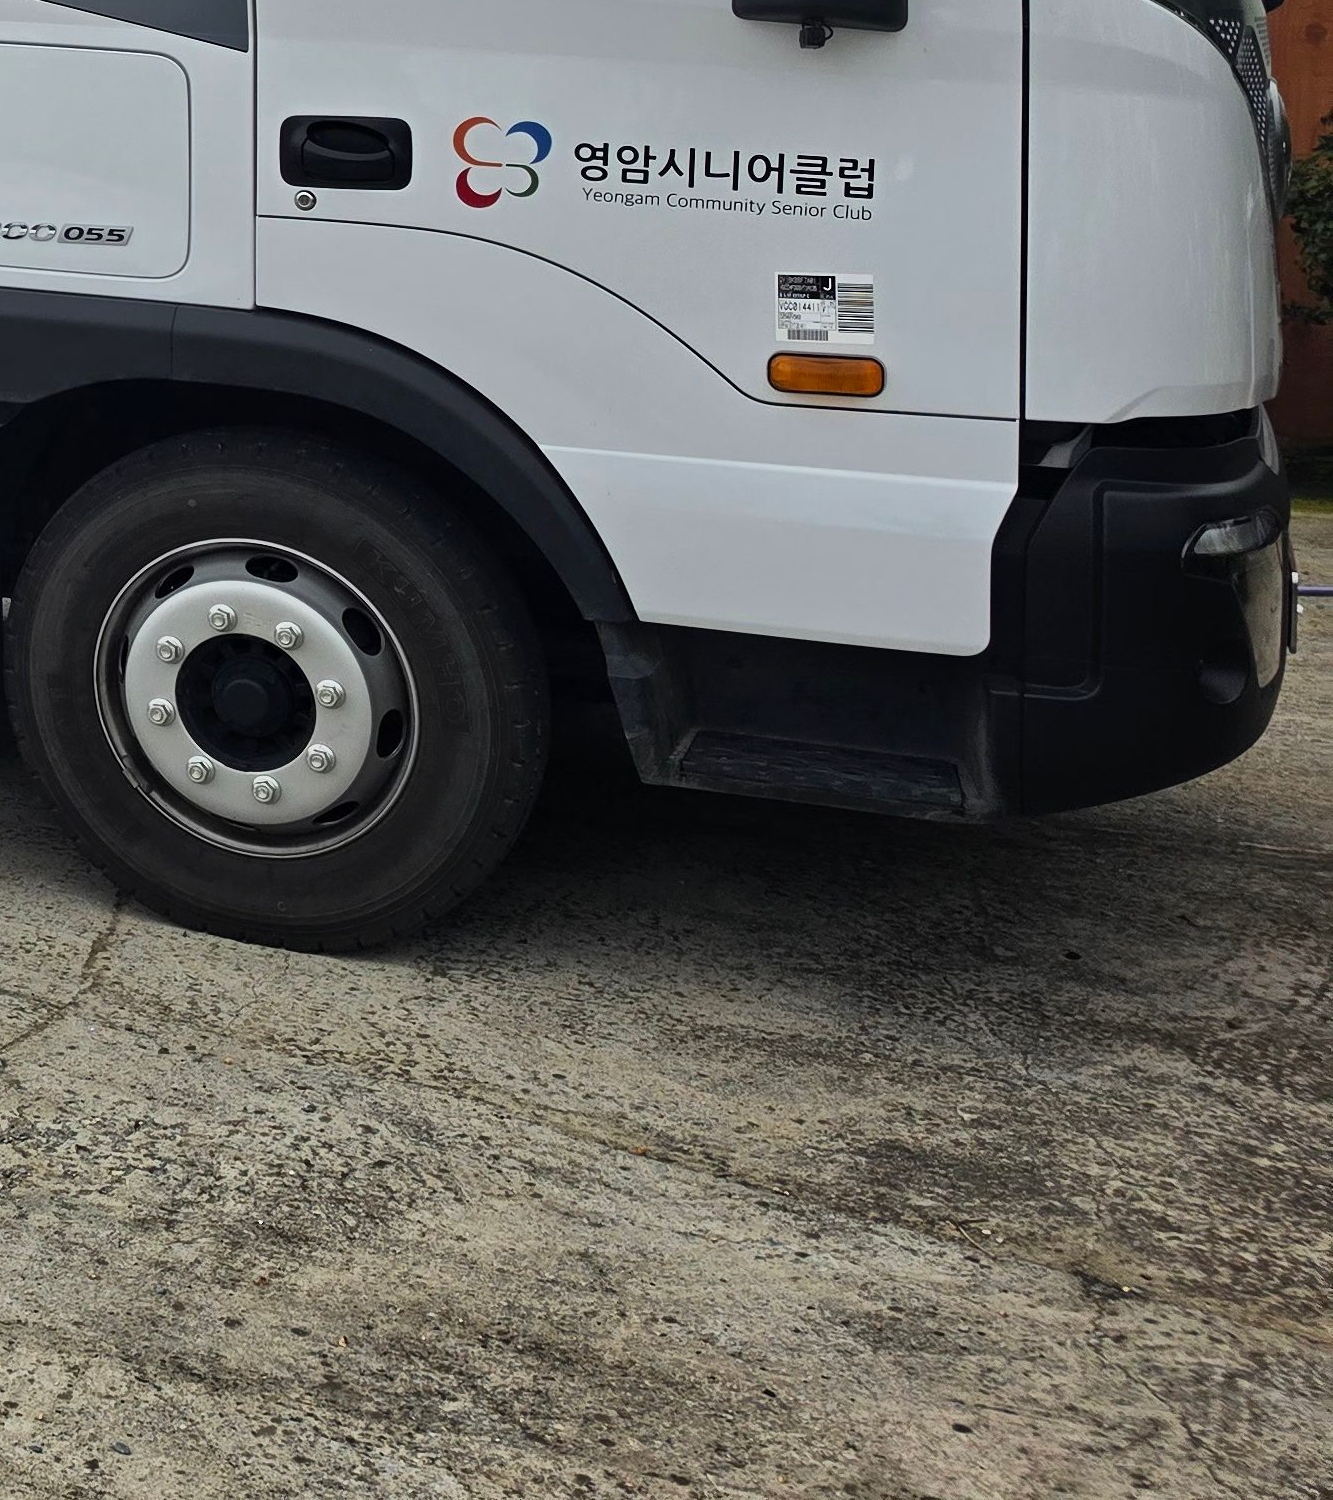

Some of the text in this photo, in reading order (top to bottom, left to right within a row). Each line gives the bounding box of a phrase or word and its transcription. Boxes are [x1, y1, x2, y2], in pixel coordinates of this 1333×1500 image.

[573, 141, 876, 201] 영암시니어클럽
[582, 187, 873, 221] Yeongam Community Senior Club
[63, 226, 127, 243] 055
